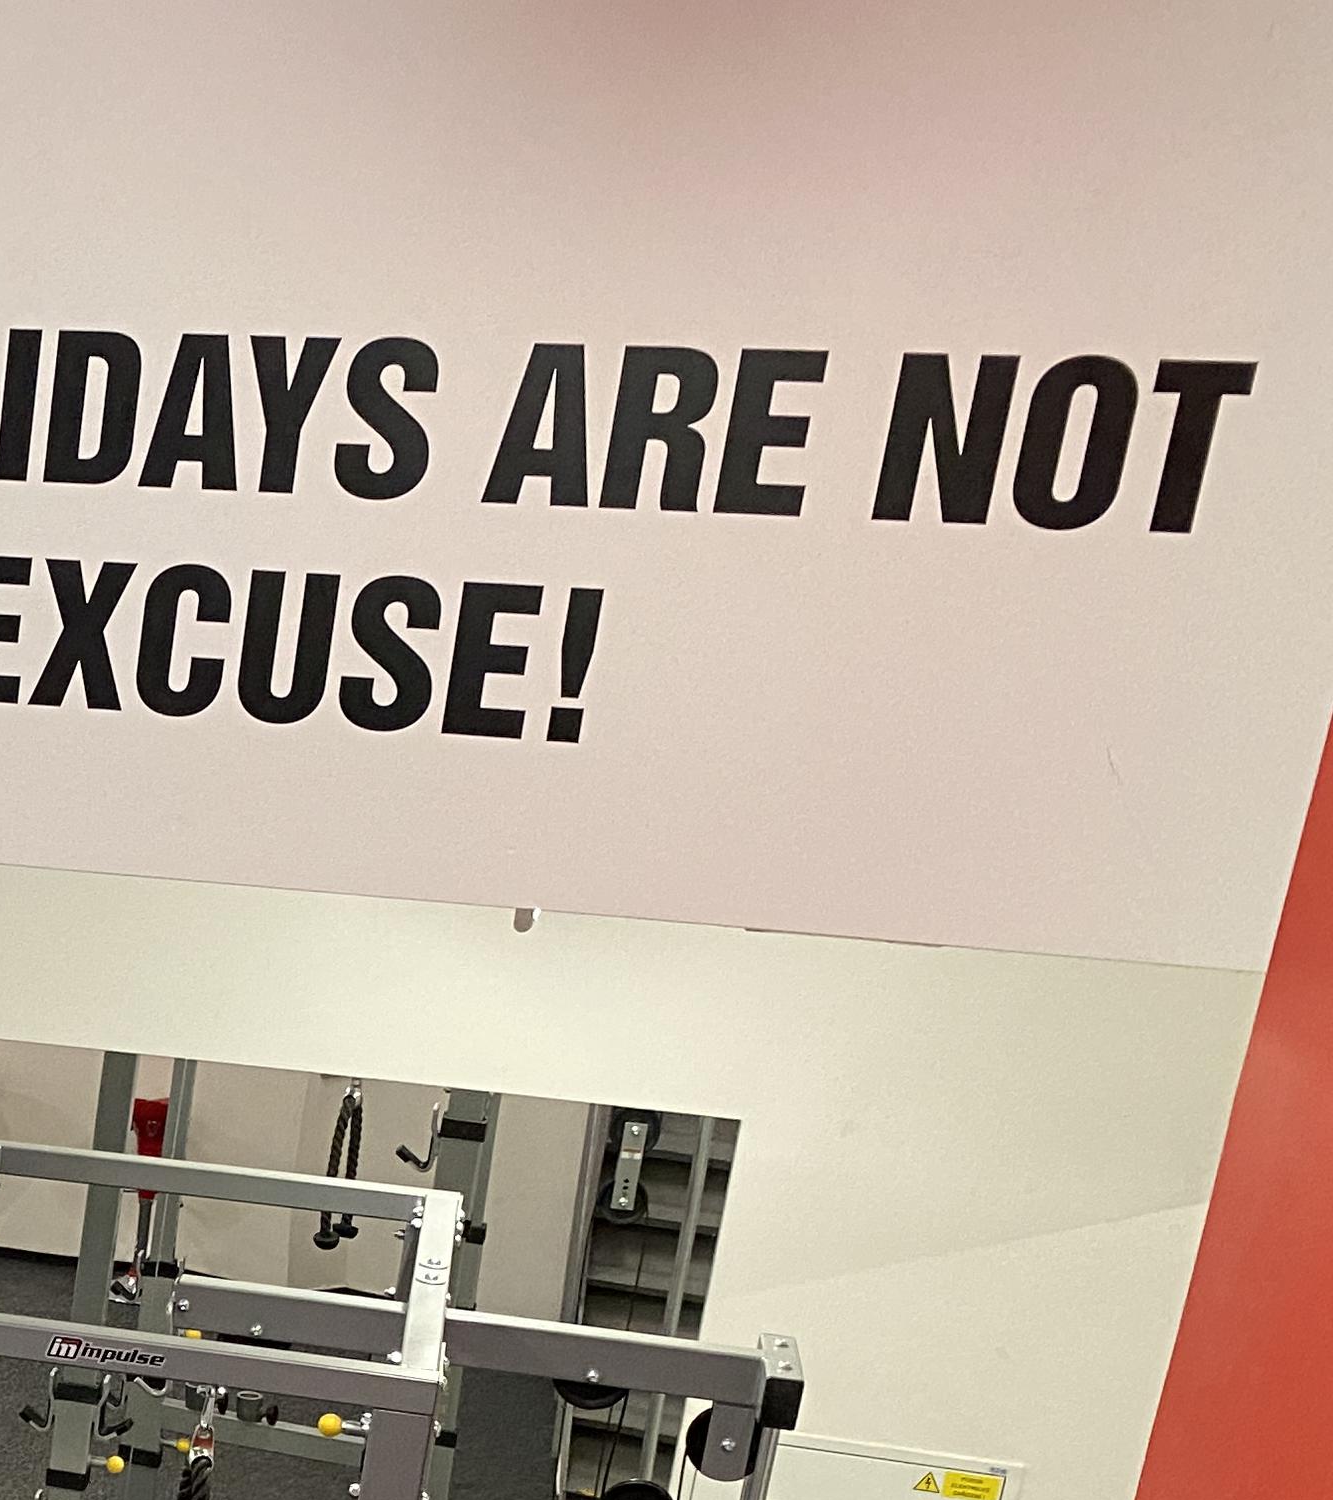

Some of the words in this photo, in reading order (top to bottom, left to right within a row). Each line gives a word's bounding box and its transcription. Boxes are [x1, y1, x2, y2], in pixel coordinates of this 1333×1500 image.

[481, 342, 829, 517] ARE
[871, 351, 1259, 534] NOT
[81, 1343, 165, 1367] impulse
